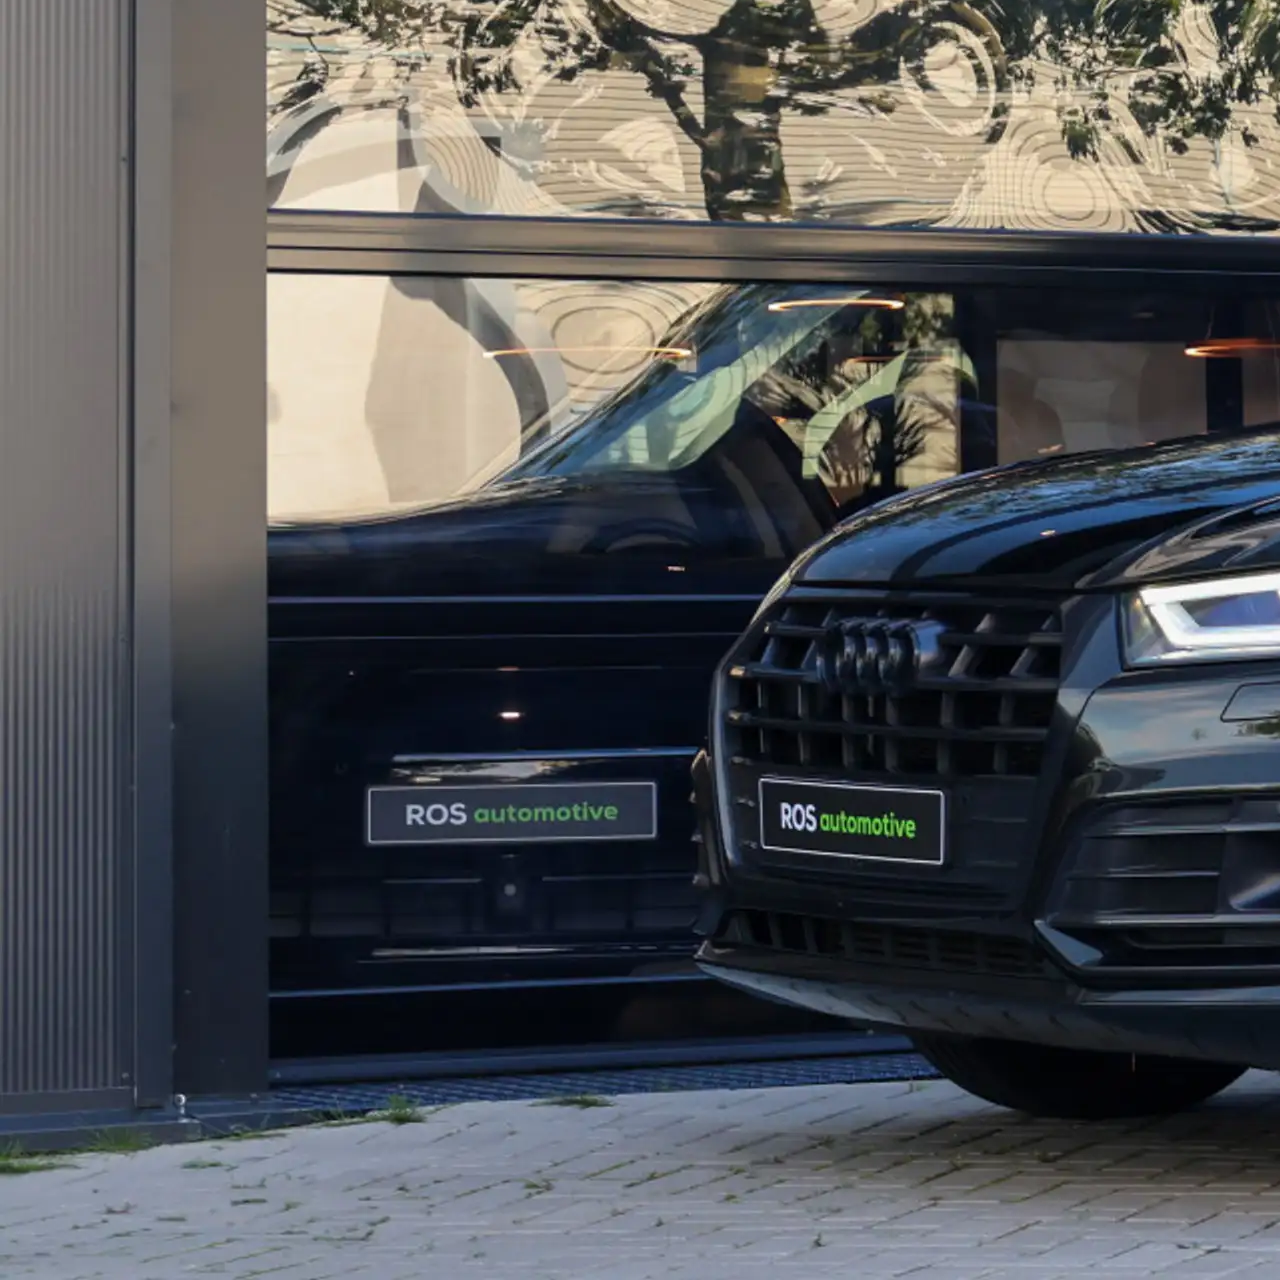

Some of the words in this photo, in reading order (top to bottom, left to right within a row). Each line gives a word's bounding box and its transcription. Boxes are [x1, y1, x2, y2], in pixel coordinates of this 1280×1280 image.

[405, 802, 467, 826] ROS
[474, 801, 619, 824] automotive
[780, 802, 817, 832] ROS
[820, 812, 917, 839] automotive
